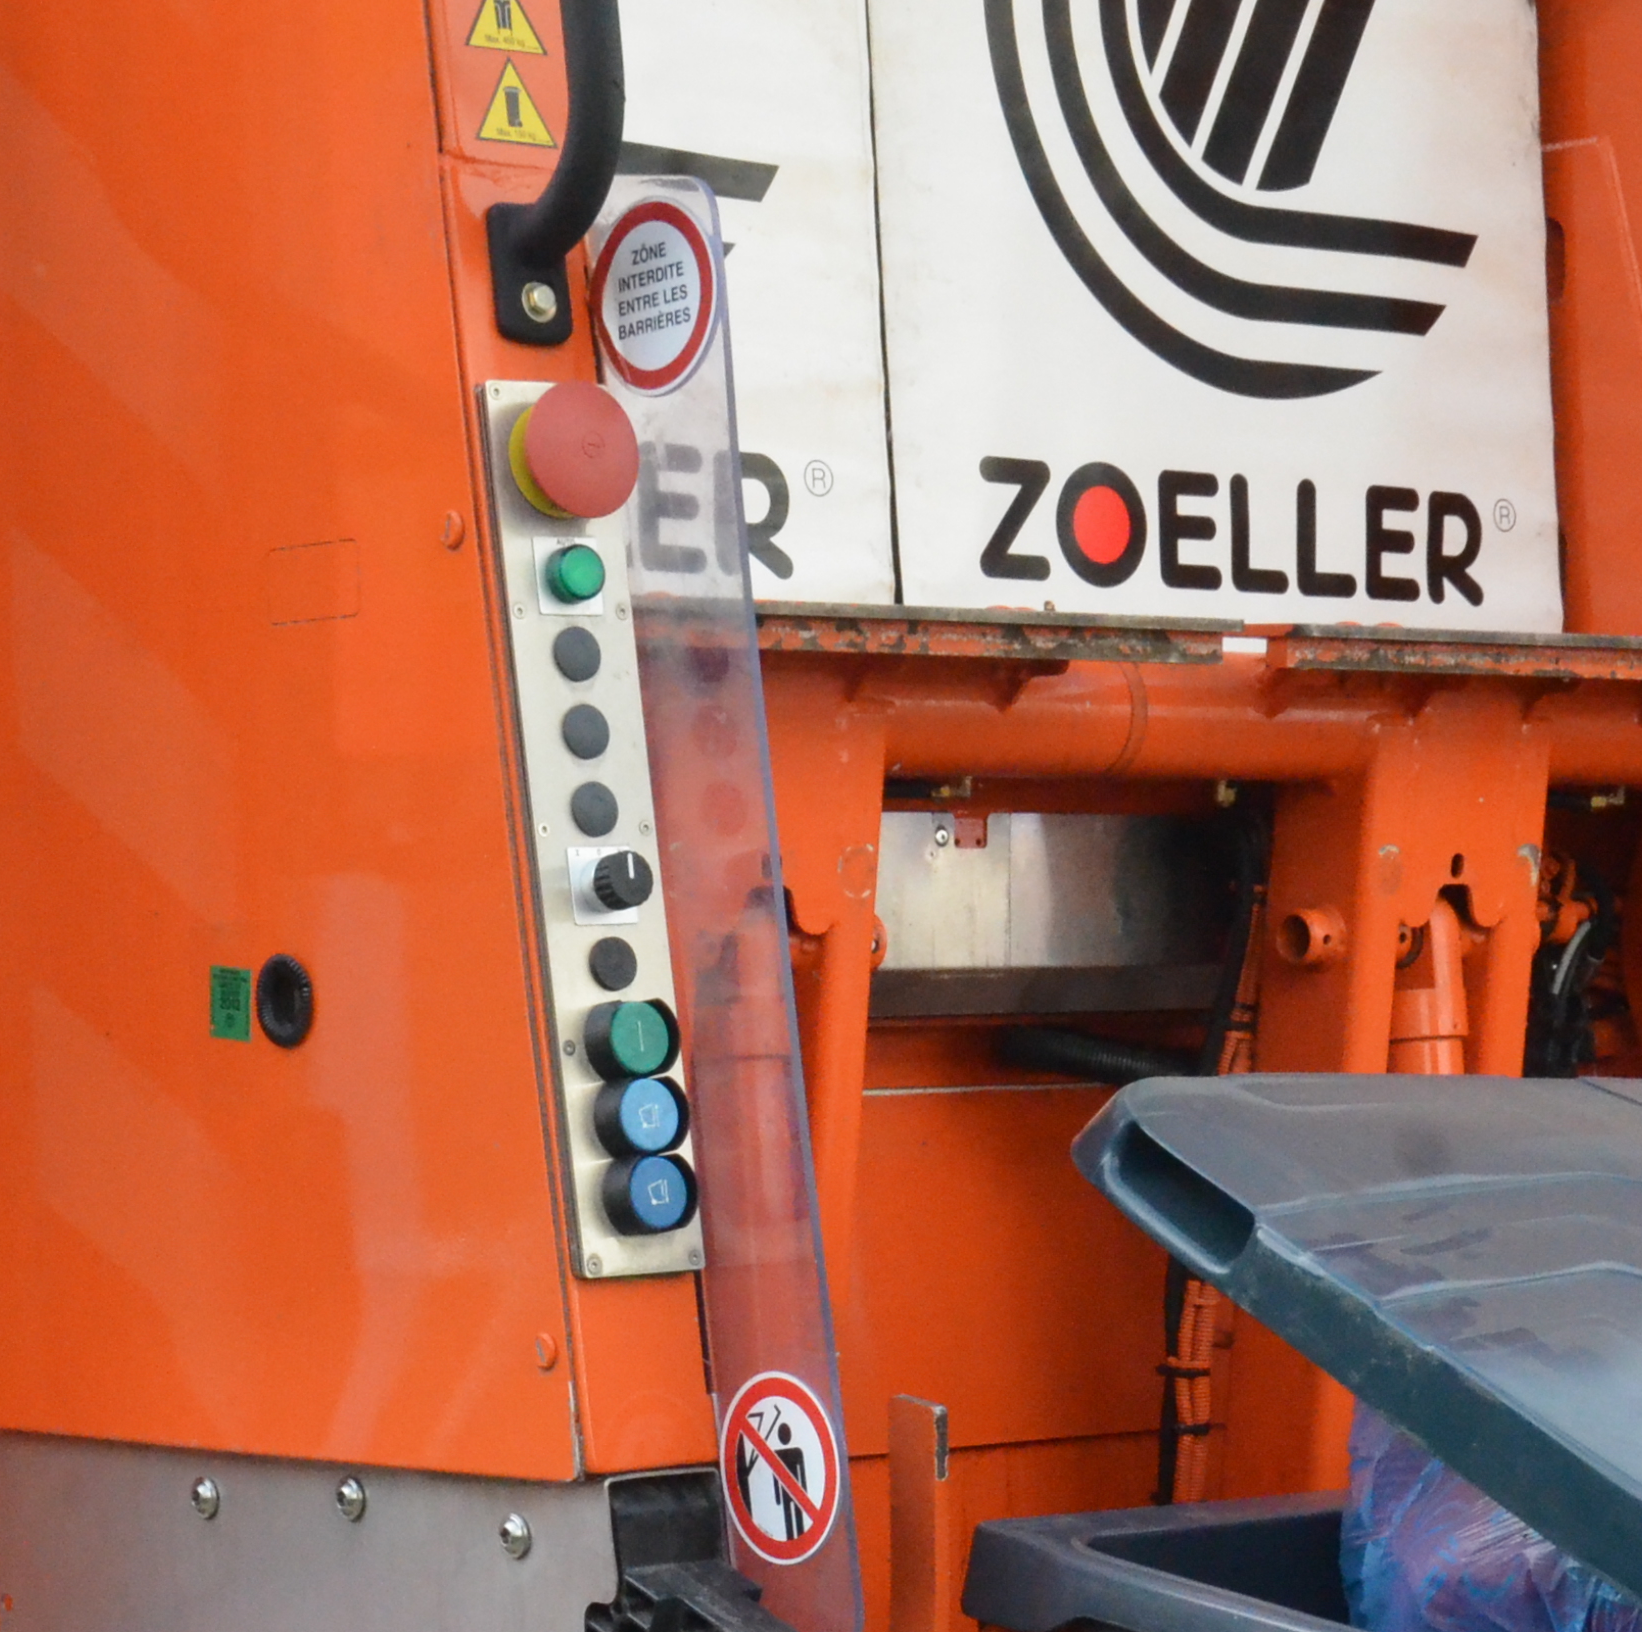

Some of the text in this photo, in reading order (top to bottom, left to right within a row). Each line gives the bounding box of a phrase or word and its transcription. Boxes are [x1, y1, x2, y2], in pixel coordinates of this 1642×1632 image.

[631, 242, 667, 266] ZÔNE
[618, 261, 684, 293] INTERDITE
[618, 284, 688, 317] ENTRE LES
[618, 306, 691, 341] BARRIÈRES
[979, 455, 1484, 607] ZOELLER
